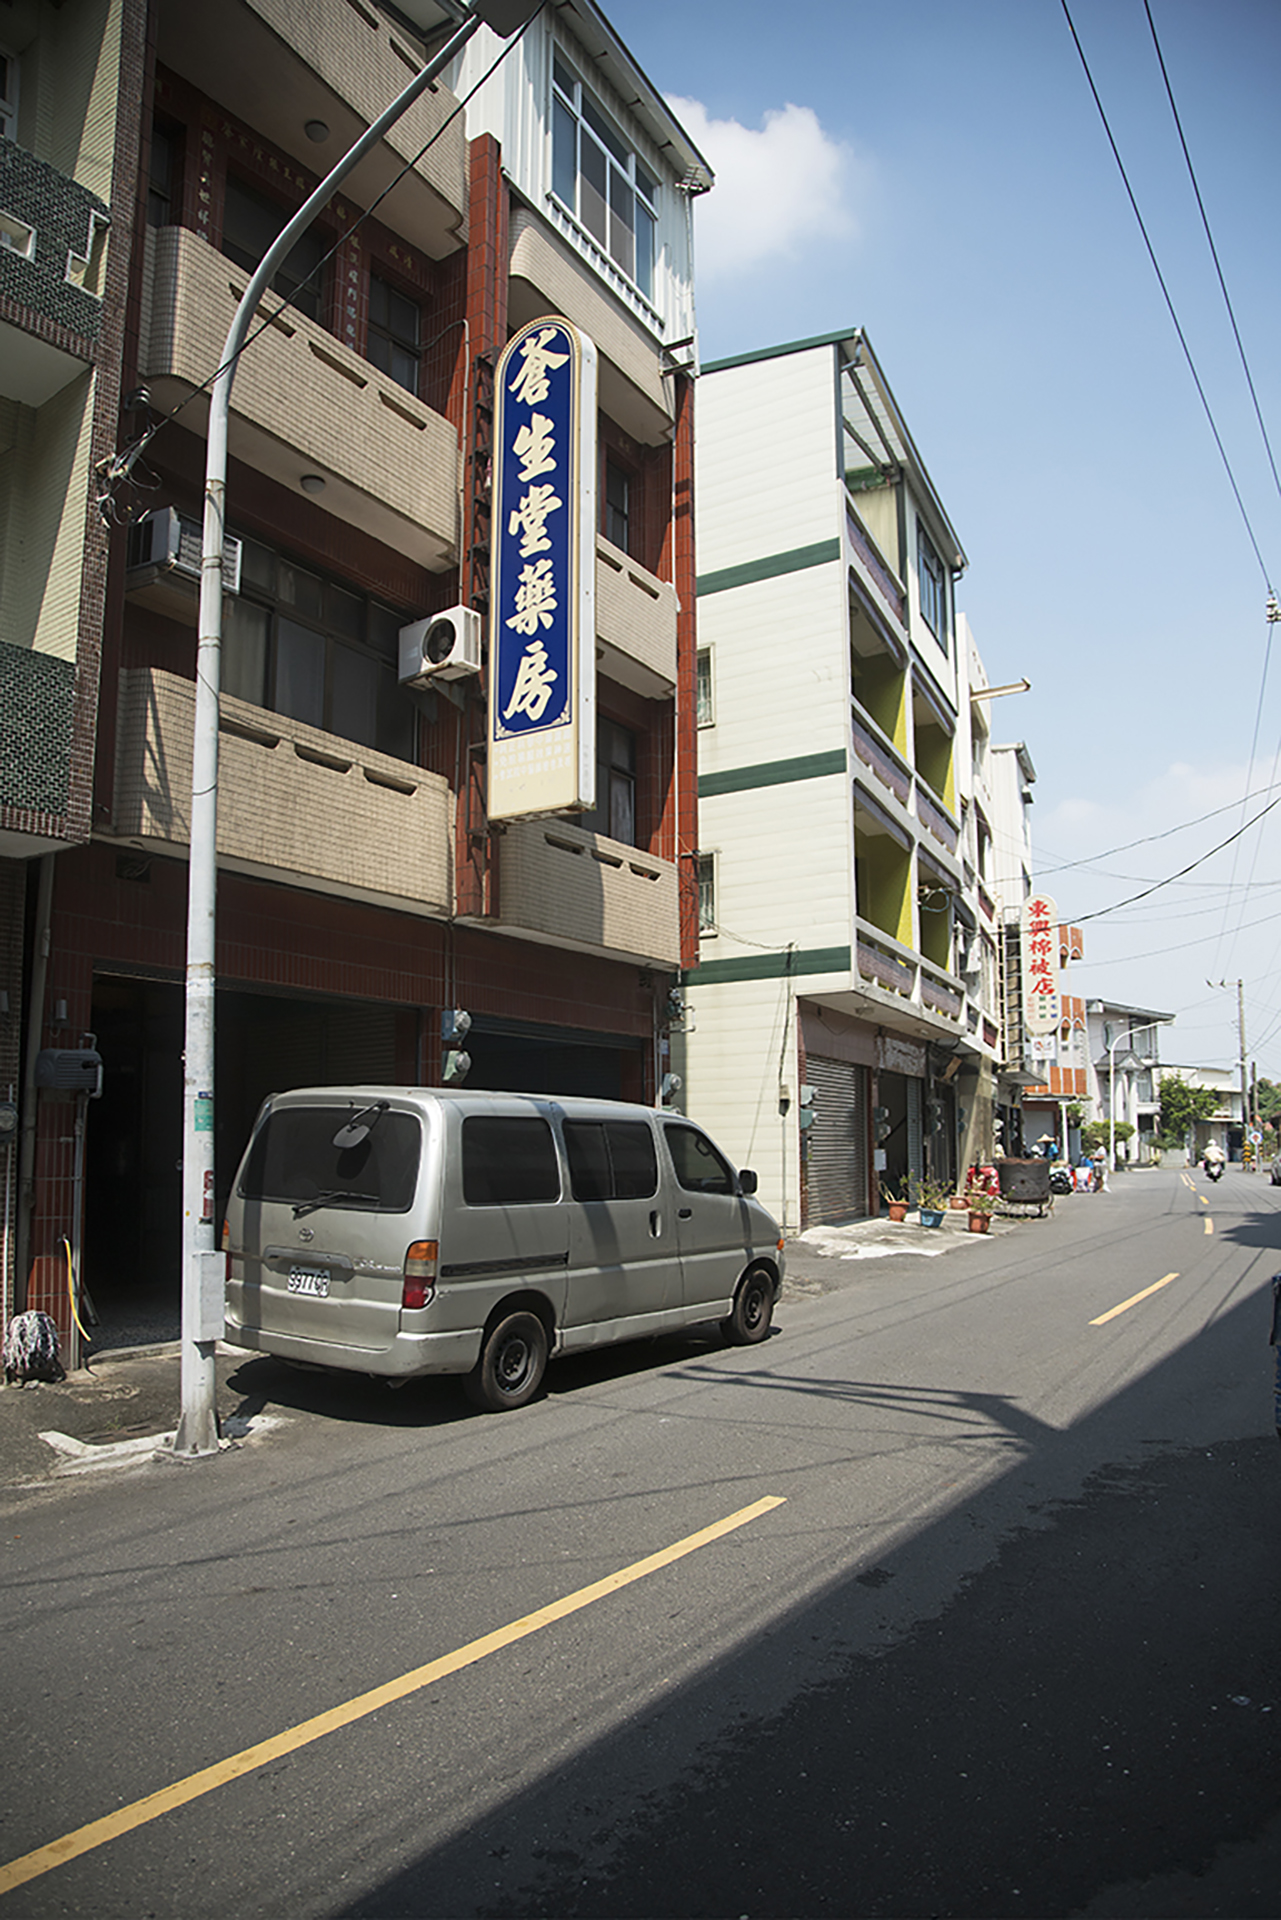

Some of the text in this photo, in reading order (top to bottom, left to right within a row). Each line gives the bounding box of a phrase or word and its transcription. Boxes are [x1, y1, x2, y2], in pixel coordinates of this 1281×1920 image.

[502, 327, 570, 722] 蒼生堂藥房
[1027, 899, 1055, 996] 東興棉被店
